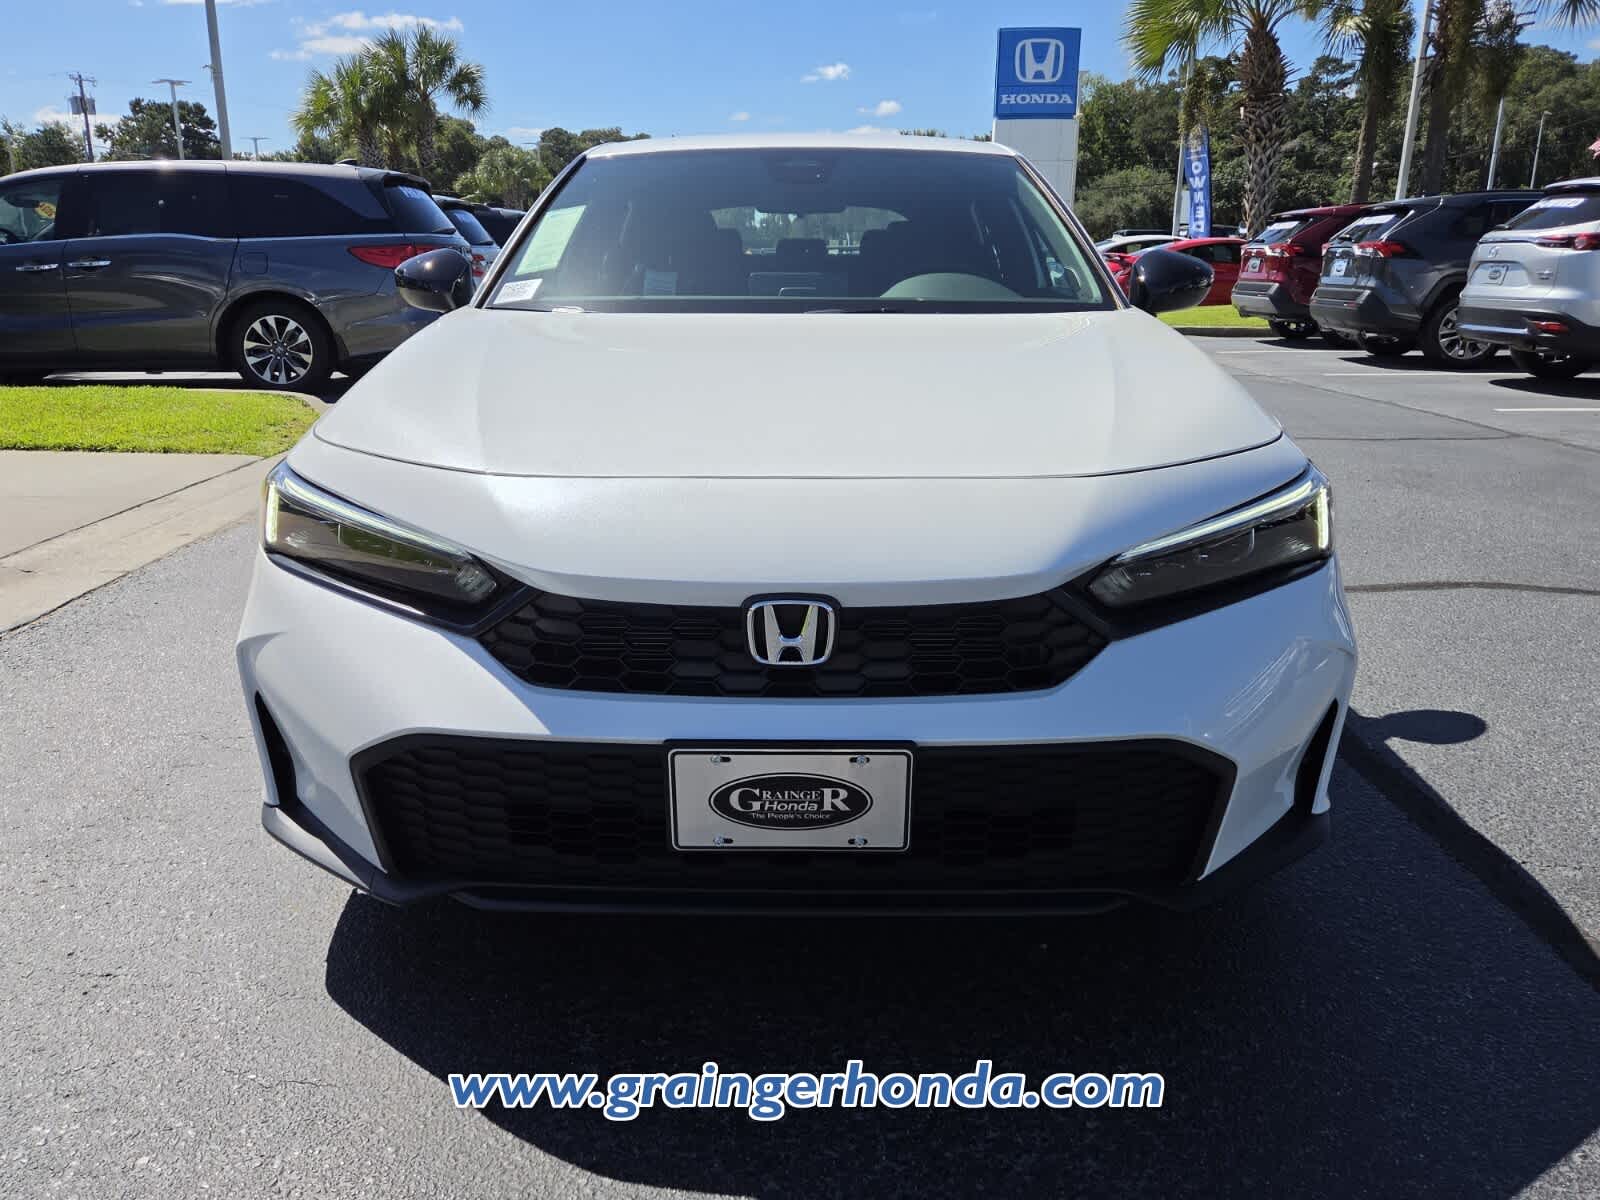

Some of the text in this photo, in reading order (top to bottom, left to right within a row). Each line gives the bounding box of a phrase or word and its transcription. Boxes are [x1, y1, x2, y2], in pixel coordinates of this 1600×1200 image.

[1000, 94, 1073, 104] HONDA
[764, 801, 818, 811] Honda
[768, 812, 802, 820] People's
